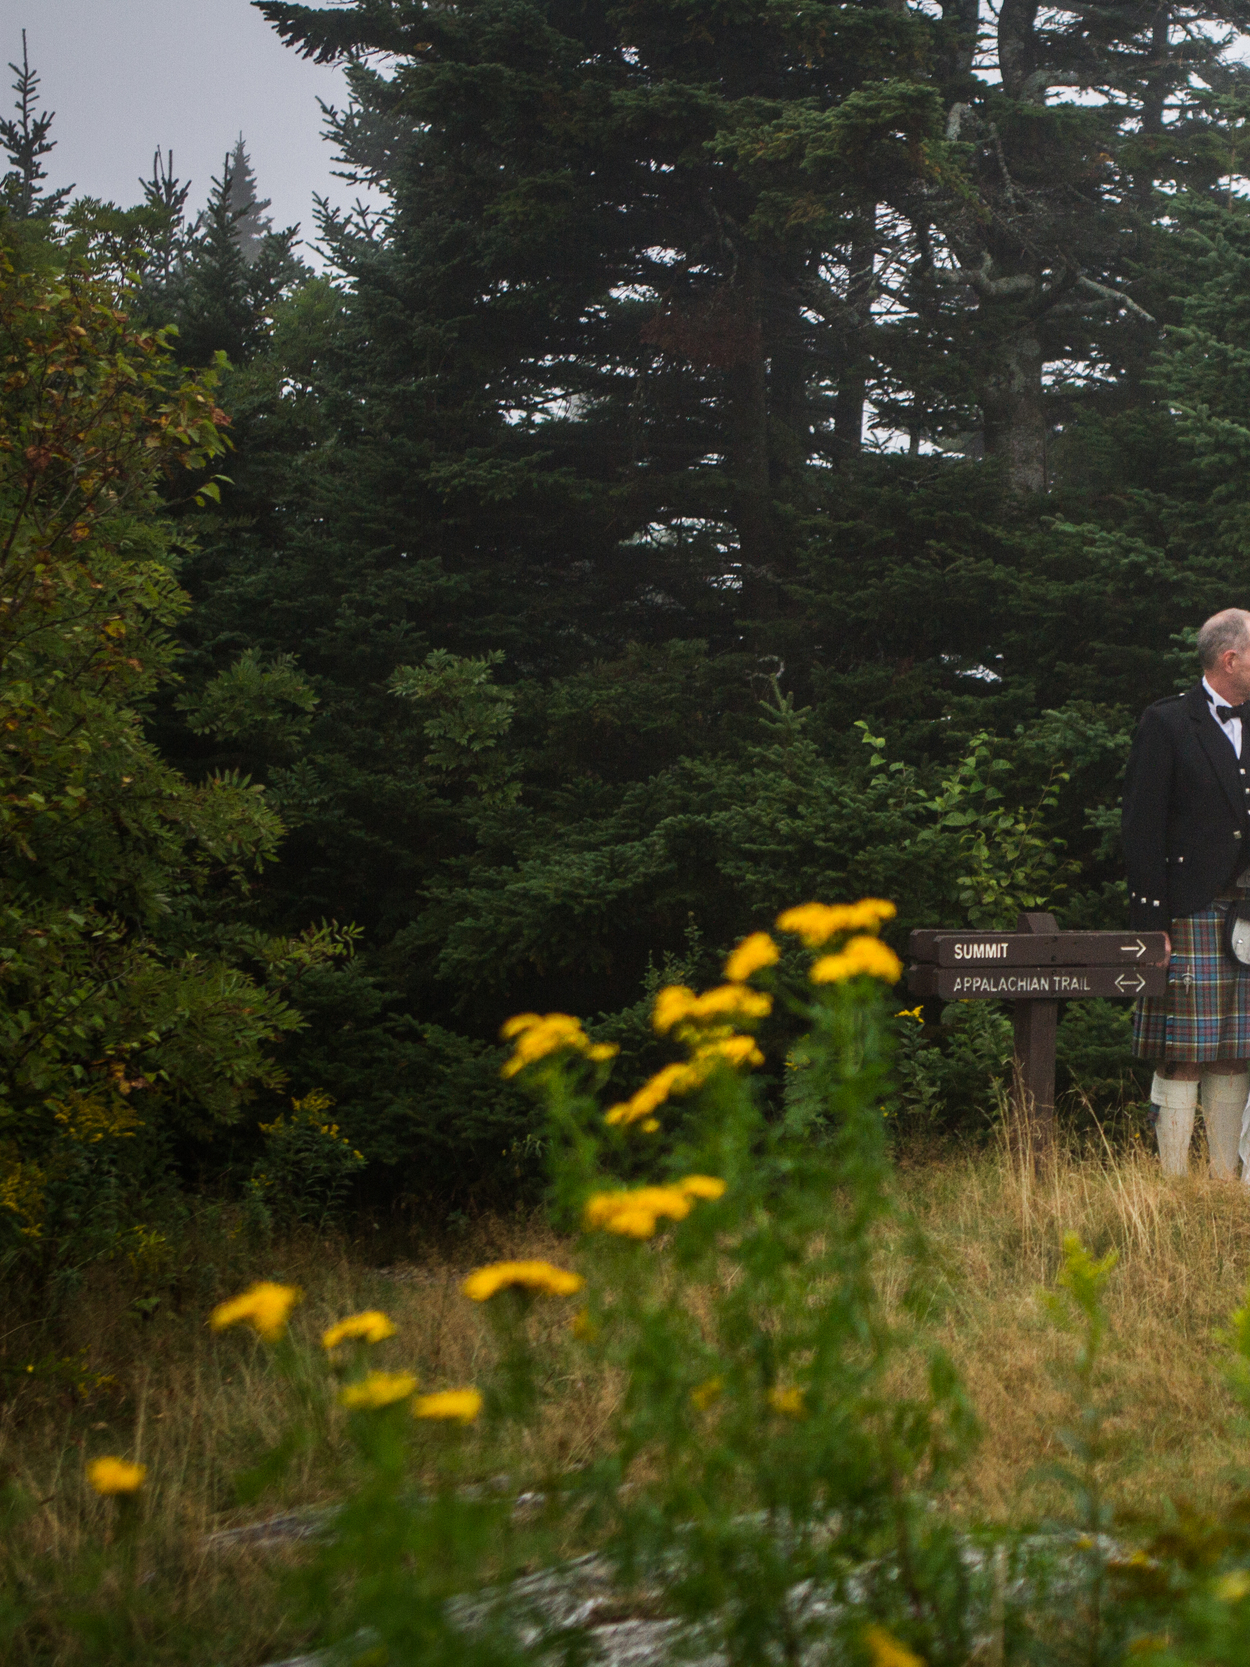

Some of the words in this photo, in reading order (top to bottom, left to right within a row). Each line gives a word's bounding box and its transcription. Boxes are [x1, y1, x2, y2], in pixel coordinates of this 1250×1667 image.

[954, 943, 1008, 959] SUMMIT
[954, 976, 1049, 991] APPALACHIAN
[1053, 976, 1091, 990] TRAIL
